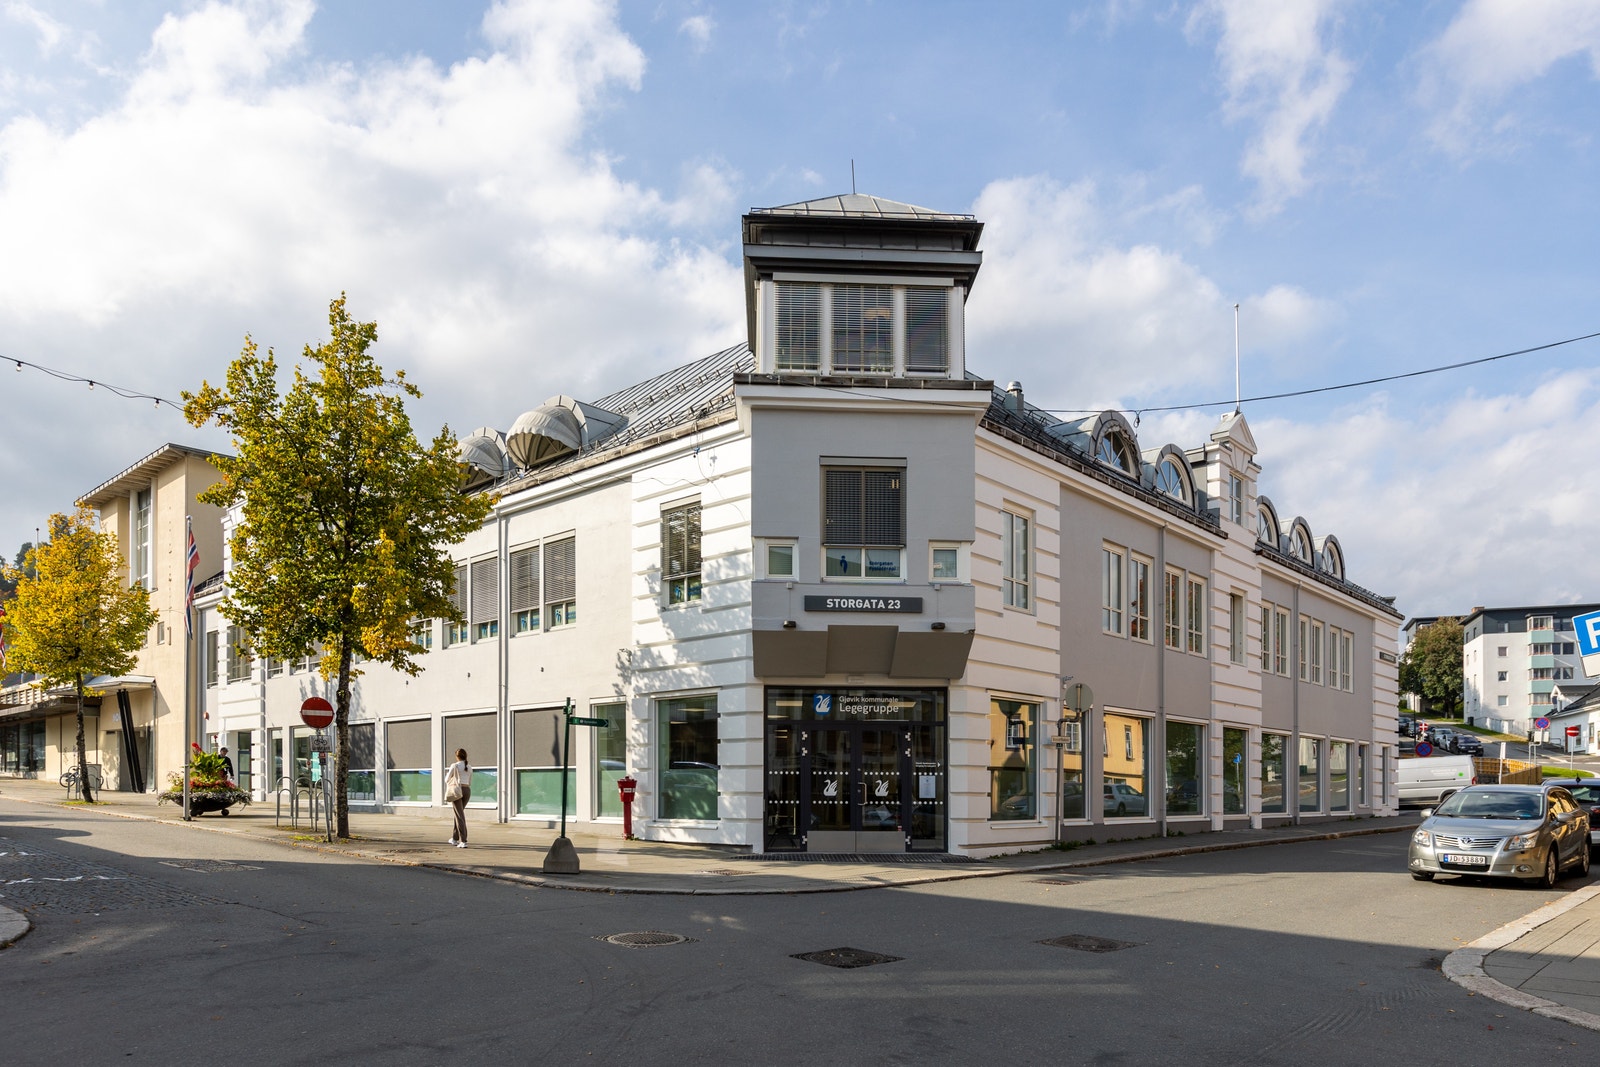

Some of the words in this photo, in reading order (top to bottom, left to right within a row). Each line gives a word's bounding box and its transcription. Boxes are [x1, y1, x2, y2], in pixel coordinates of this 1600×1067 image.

[826, 599, 885, 609] STORGATA
[888, 600, 901, 609] 23
[839, 703, 899, 714] Legegruppe
